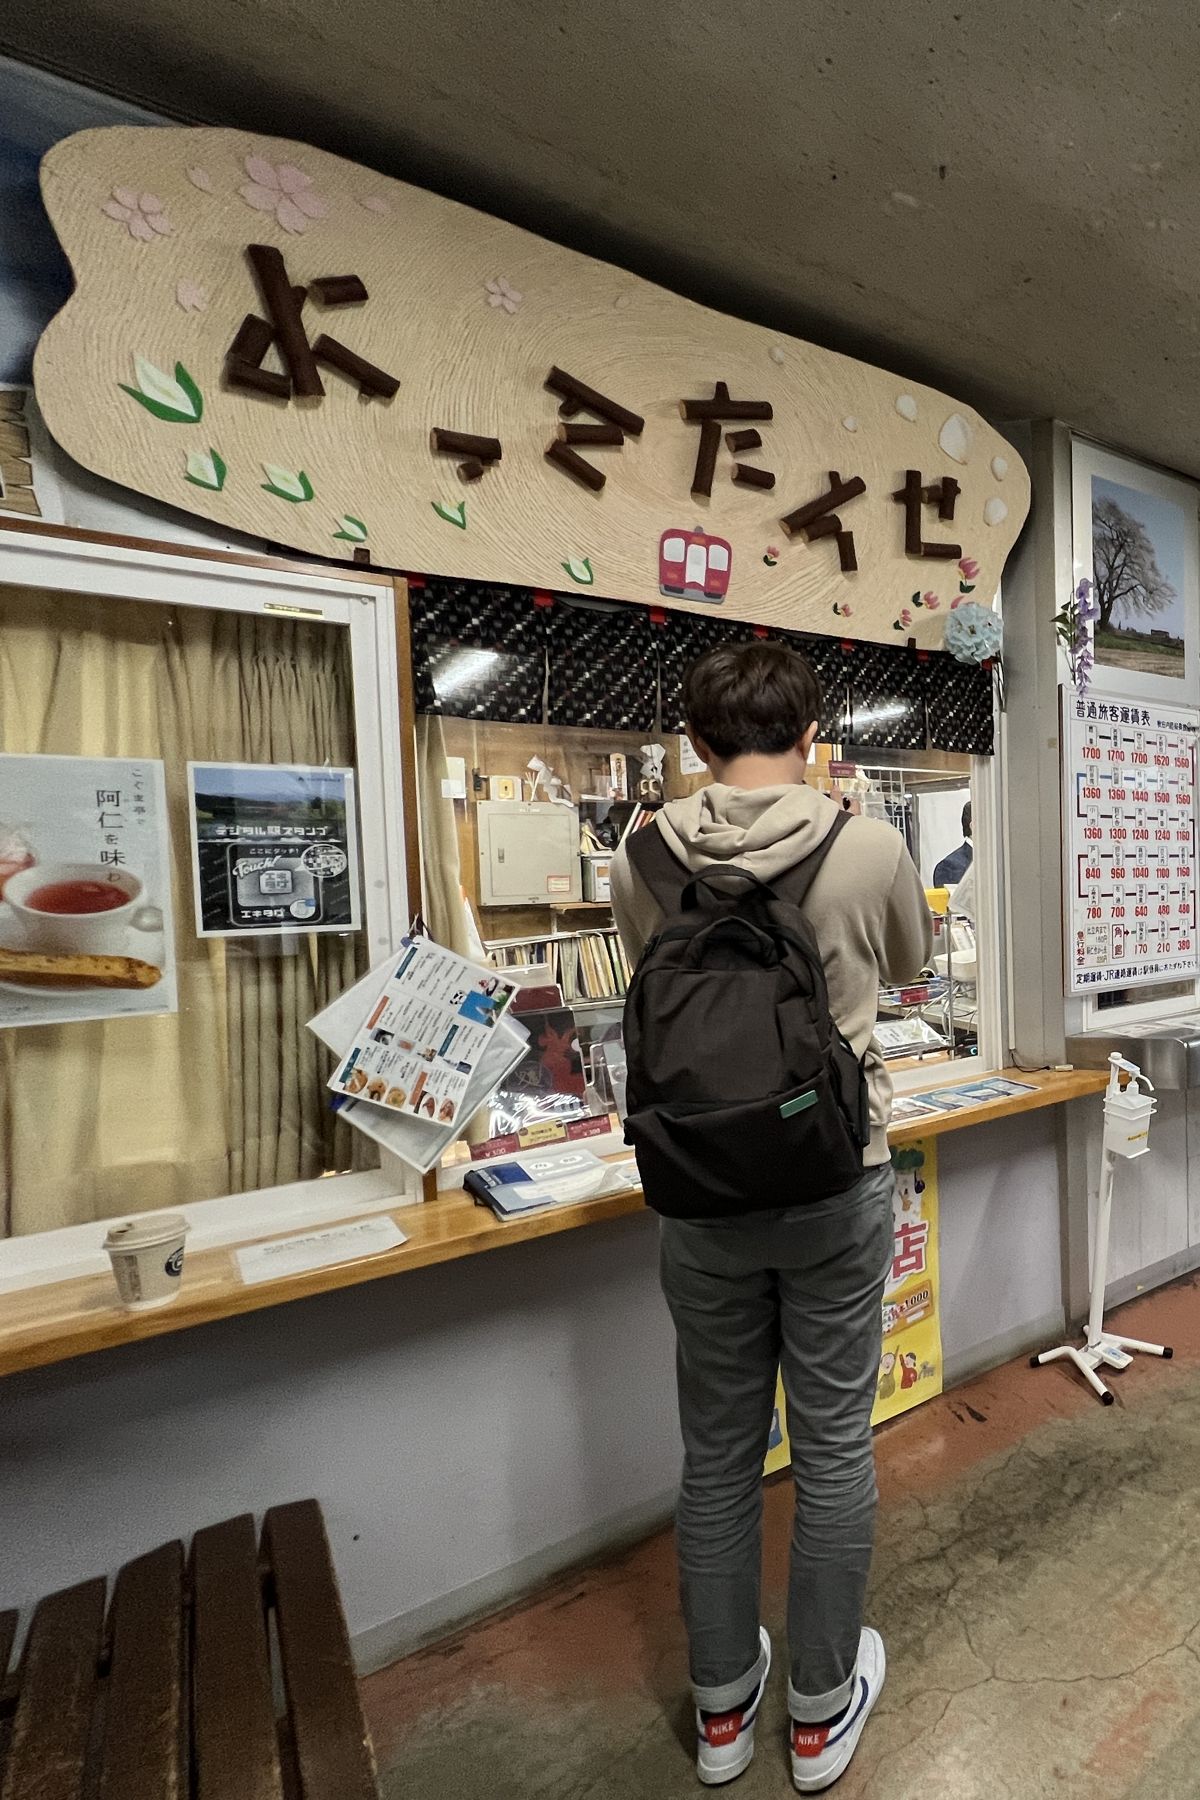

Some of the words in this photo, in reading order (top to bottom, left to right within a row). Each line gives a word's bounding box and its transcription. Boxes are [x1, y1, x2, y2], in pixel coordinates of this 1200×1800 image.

[1076, 700, 1150, 726] 普通旅客運賃表
[1082, 746, 1101, 759] 1700
[1107, 749, 1125, 762] 1700
[1131, 752, 1148, 764] 1700
[1154, 754, 1170, 766] 1620
[1082, 787, 1101, 799] 1360
[1108, 789, 1126, 801] 1360
[1154, 792, 1170, 803] 1500
[215, 825, 329, 837] デジタル駅スタンプ
[1083, 828, 1102, 840] 1360
[1109, 828, 1127, 840] 1300
[1132, 829, 1149, 841] 1240
[1155, 829, 1171, 841] 1240
[232, 855, 282, 880] Touch!
[1085, 867, 1101, 879] 840
[1110, 867, 1126, 879] 960
[1132, 867, 1149, 878] 1040
[1156, 868, 1170, 878] 1100
[241, 907, 285, 919] エキタグ
[1110, 906, 1125, 918] 700
[1134, 906, 1148, 917] 640
[1134, 943, 1148, 955] 170
[1157, 942, 1171, 953] 210
[711, 1720, 734, 1735] NIKE
[798, 1734, 820, 1746] NIKE
